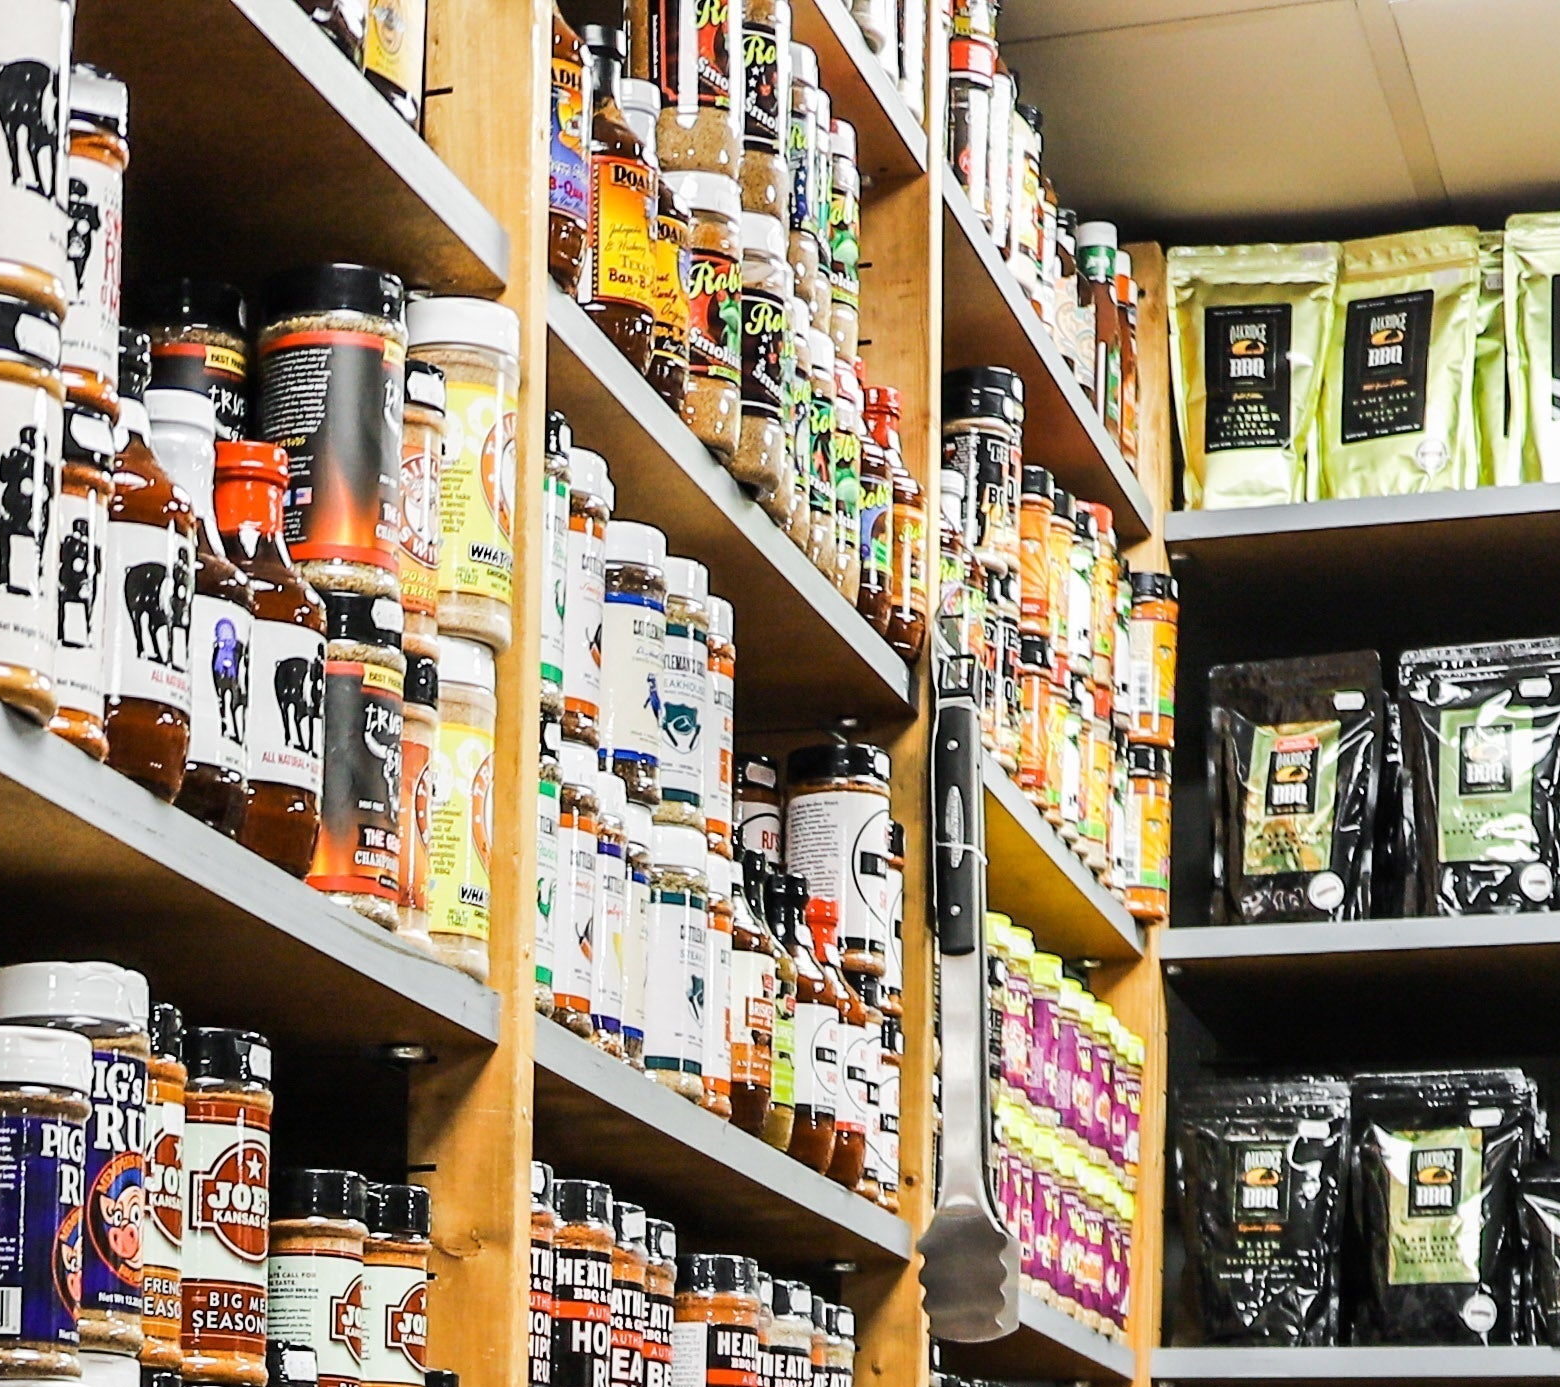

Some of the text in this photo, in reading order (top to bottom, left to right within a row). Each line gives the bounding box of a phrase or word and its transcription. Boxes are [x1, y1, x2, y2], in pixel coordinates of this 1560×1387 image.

[1368, 345, 1402, 368] BBQ
[1230, 356, 1265, 378] BBQ
[212, 1211, 259, 1227] KANSAS
[210, 1291, 242, 1309] BIG
